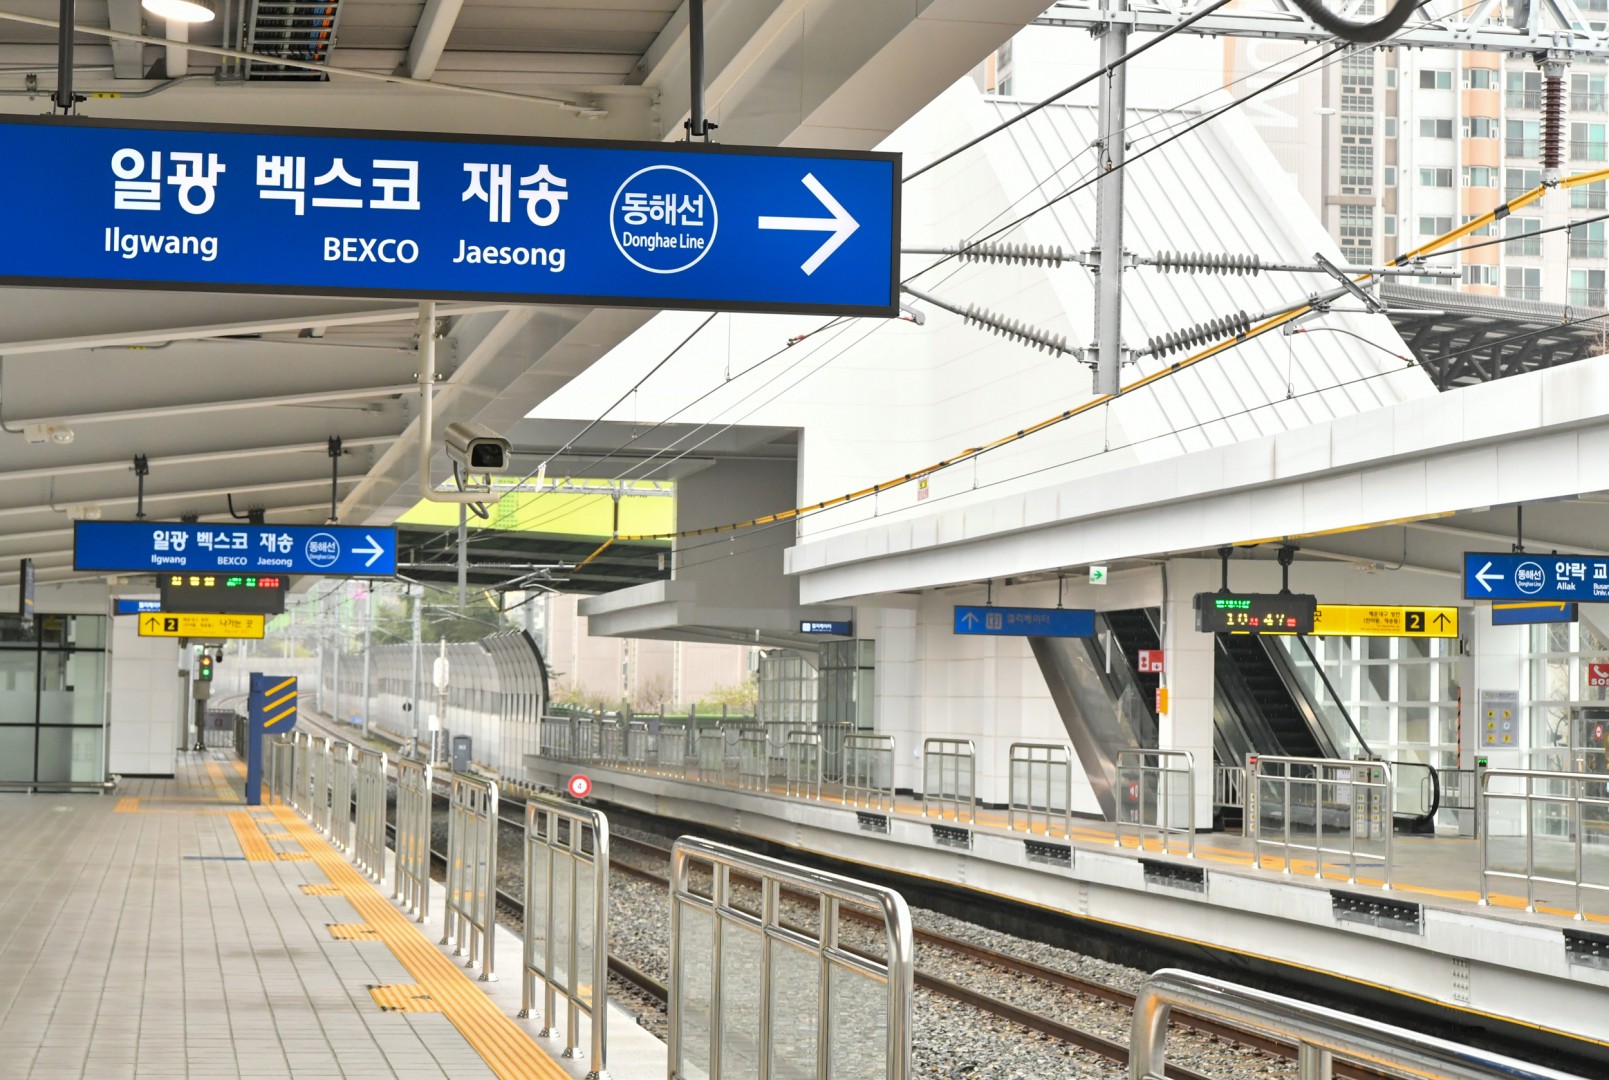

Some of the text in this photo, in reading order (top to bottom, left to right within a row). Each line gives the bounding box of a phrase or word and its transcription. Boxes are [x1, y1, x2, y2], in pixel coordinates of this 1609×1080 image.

[110, 148, 569, 227] 일광 벡스코 재송
[621, 192, 704, 226] 동해선
[623, 231, 705, 251] Donghae Line
[105, 226, 566, 273] Ilgwang BEXCO Jaesong
[153, 530, 294, 553] 일광 벡스코 재송
[309, 541, 336, 553] 동해선
[151, 554, 293, 567] Ilgwang BEXCO Jaesong
[1518, 569, 1542, 581] 동해선
[1555, 561, 1608, 581] 안락 교
[1556, 581, 1576, 590] Allak
[167, 620, 175, 630] 2
[1410, 615, 1420, 629] 2
[577, 782, 582, 790] 4
